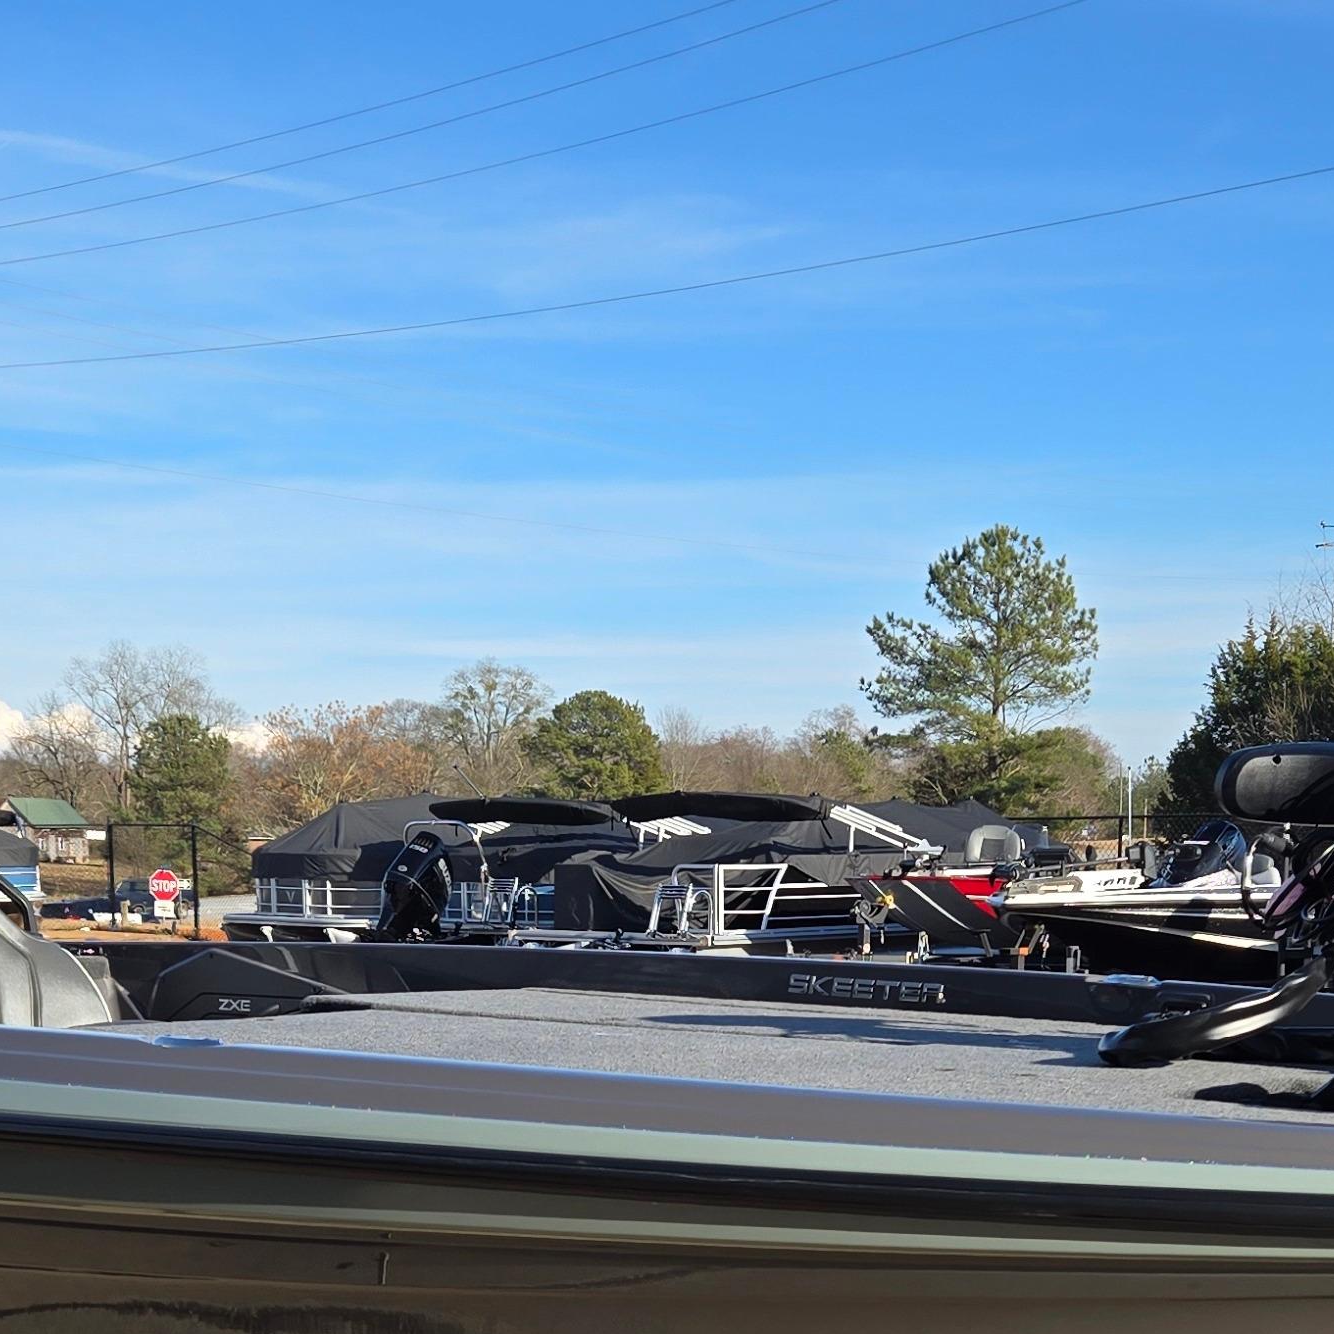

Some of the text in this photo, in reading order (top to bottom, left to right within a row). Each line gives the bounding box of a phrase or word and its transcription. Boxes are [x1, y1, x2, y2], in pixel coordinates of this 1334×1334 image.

[151, 879, 177, 893] STOP
[788, 973, 946, 1004] SKEETER
[218, 998, 251, 1012] ZXE
